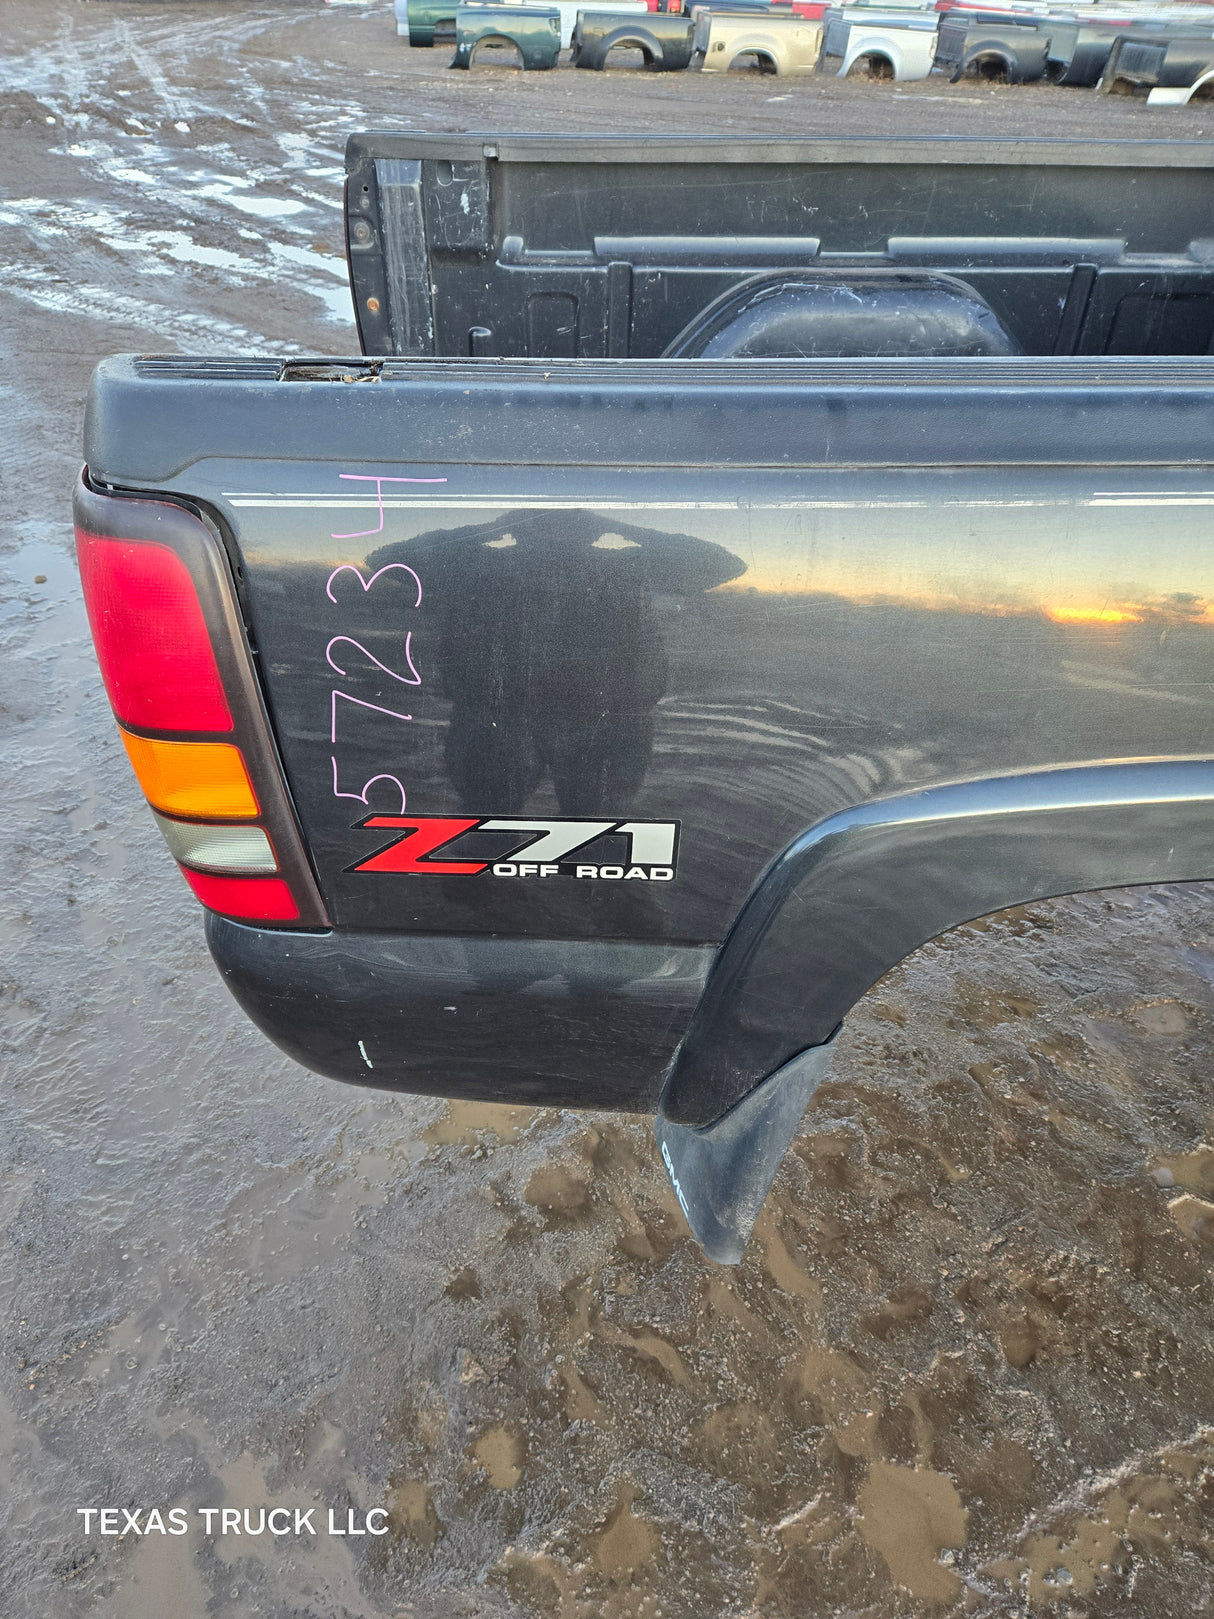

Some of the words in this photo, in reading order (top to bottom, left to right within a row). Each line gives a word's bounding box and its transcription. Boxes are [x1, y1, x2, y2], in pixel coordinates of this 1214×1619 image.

[326, 473, 448, 815] 57234
[352, 815, 677, 875] Z71
[492, 863, 559, 878] OFF
[576, 864, 675, 881] ROAD
